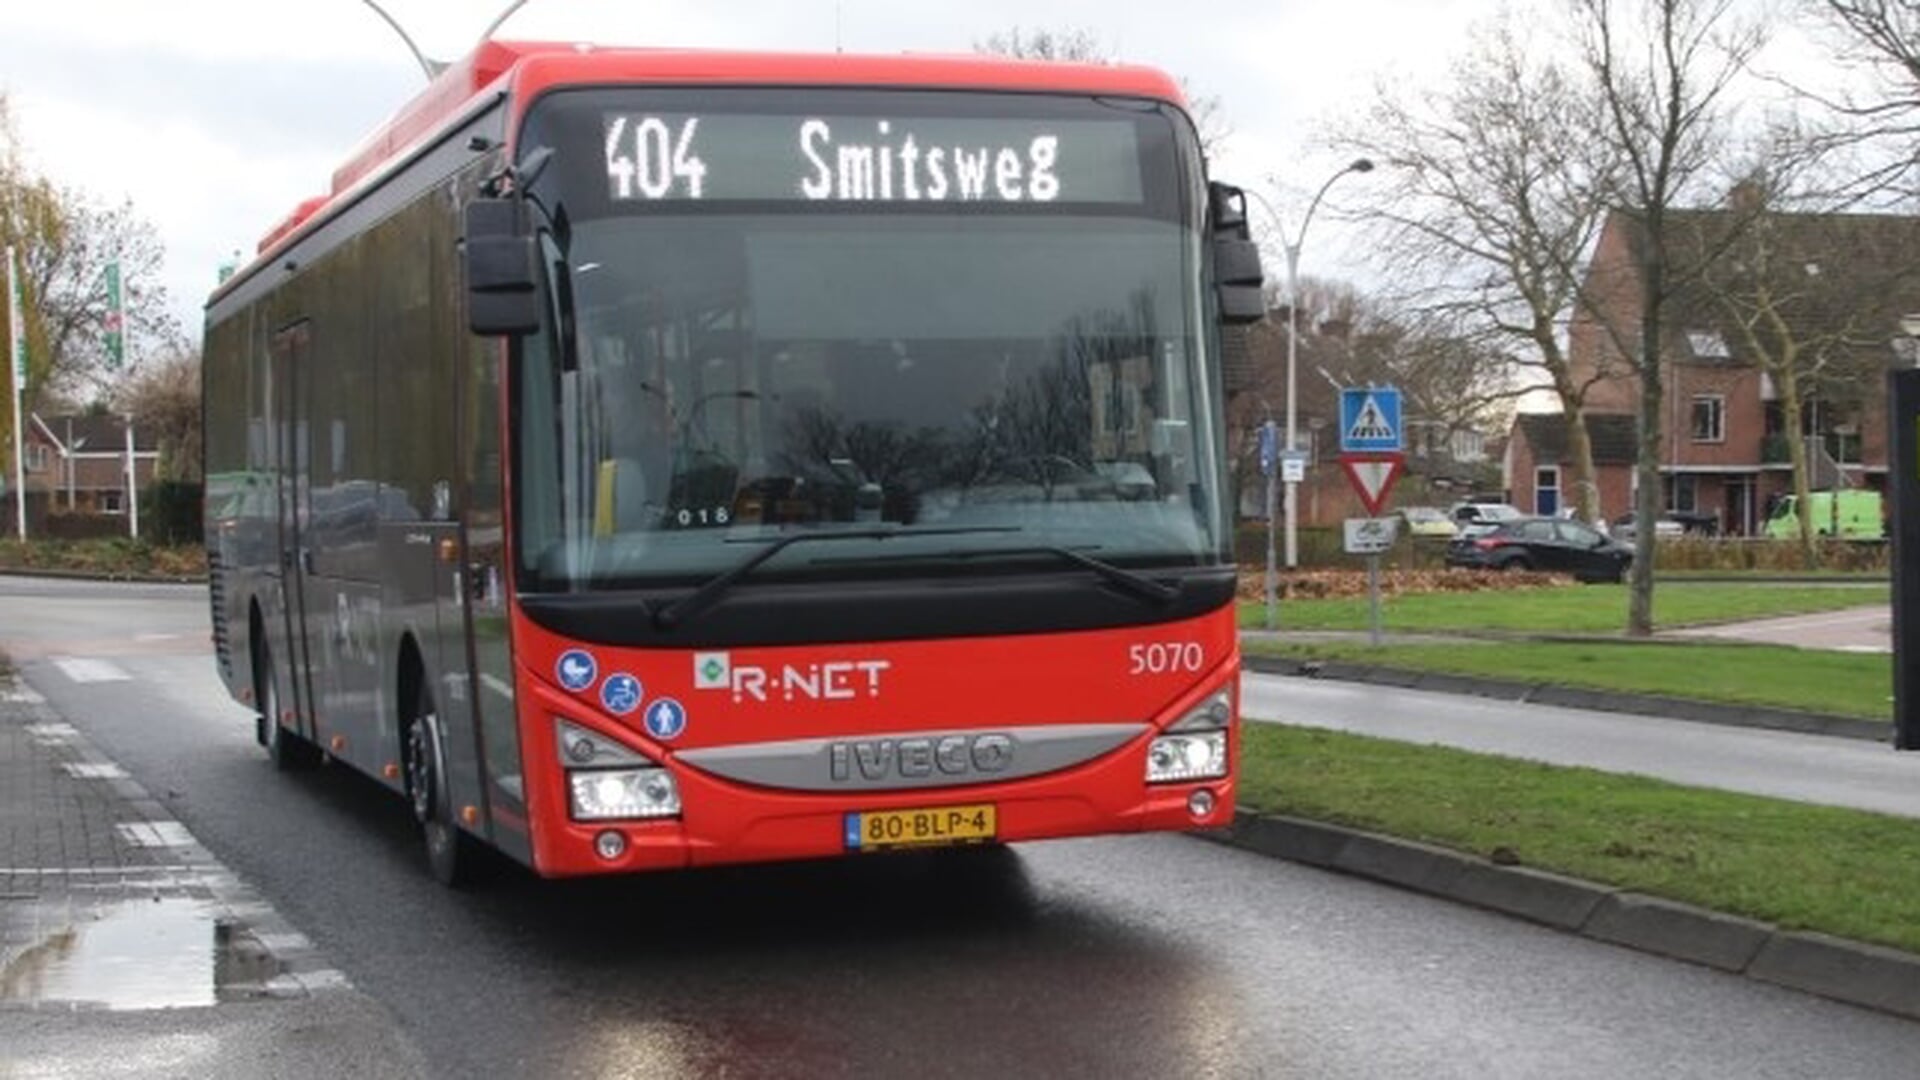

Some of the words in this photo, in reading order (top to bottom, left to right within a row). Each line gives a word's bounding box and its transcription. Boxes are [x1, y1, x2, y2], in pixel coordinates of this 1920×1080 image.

[605, 117, 706, 199] 404
[800, 119, 1060, 201] Smitsweg
[1129, 643, 1203, 675] 5070
[831, 734, 1015, 781] IVECO
